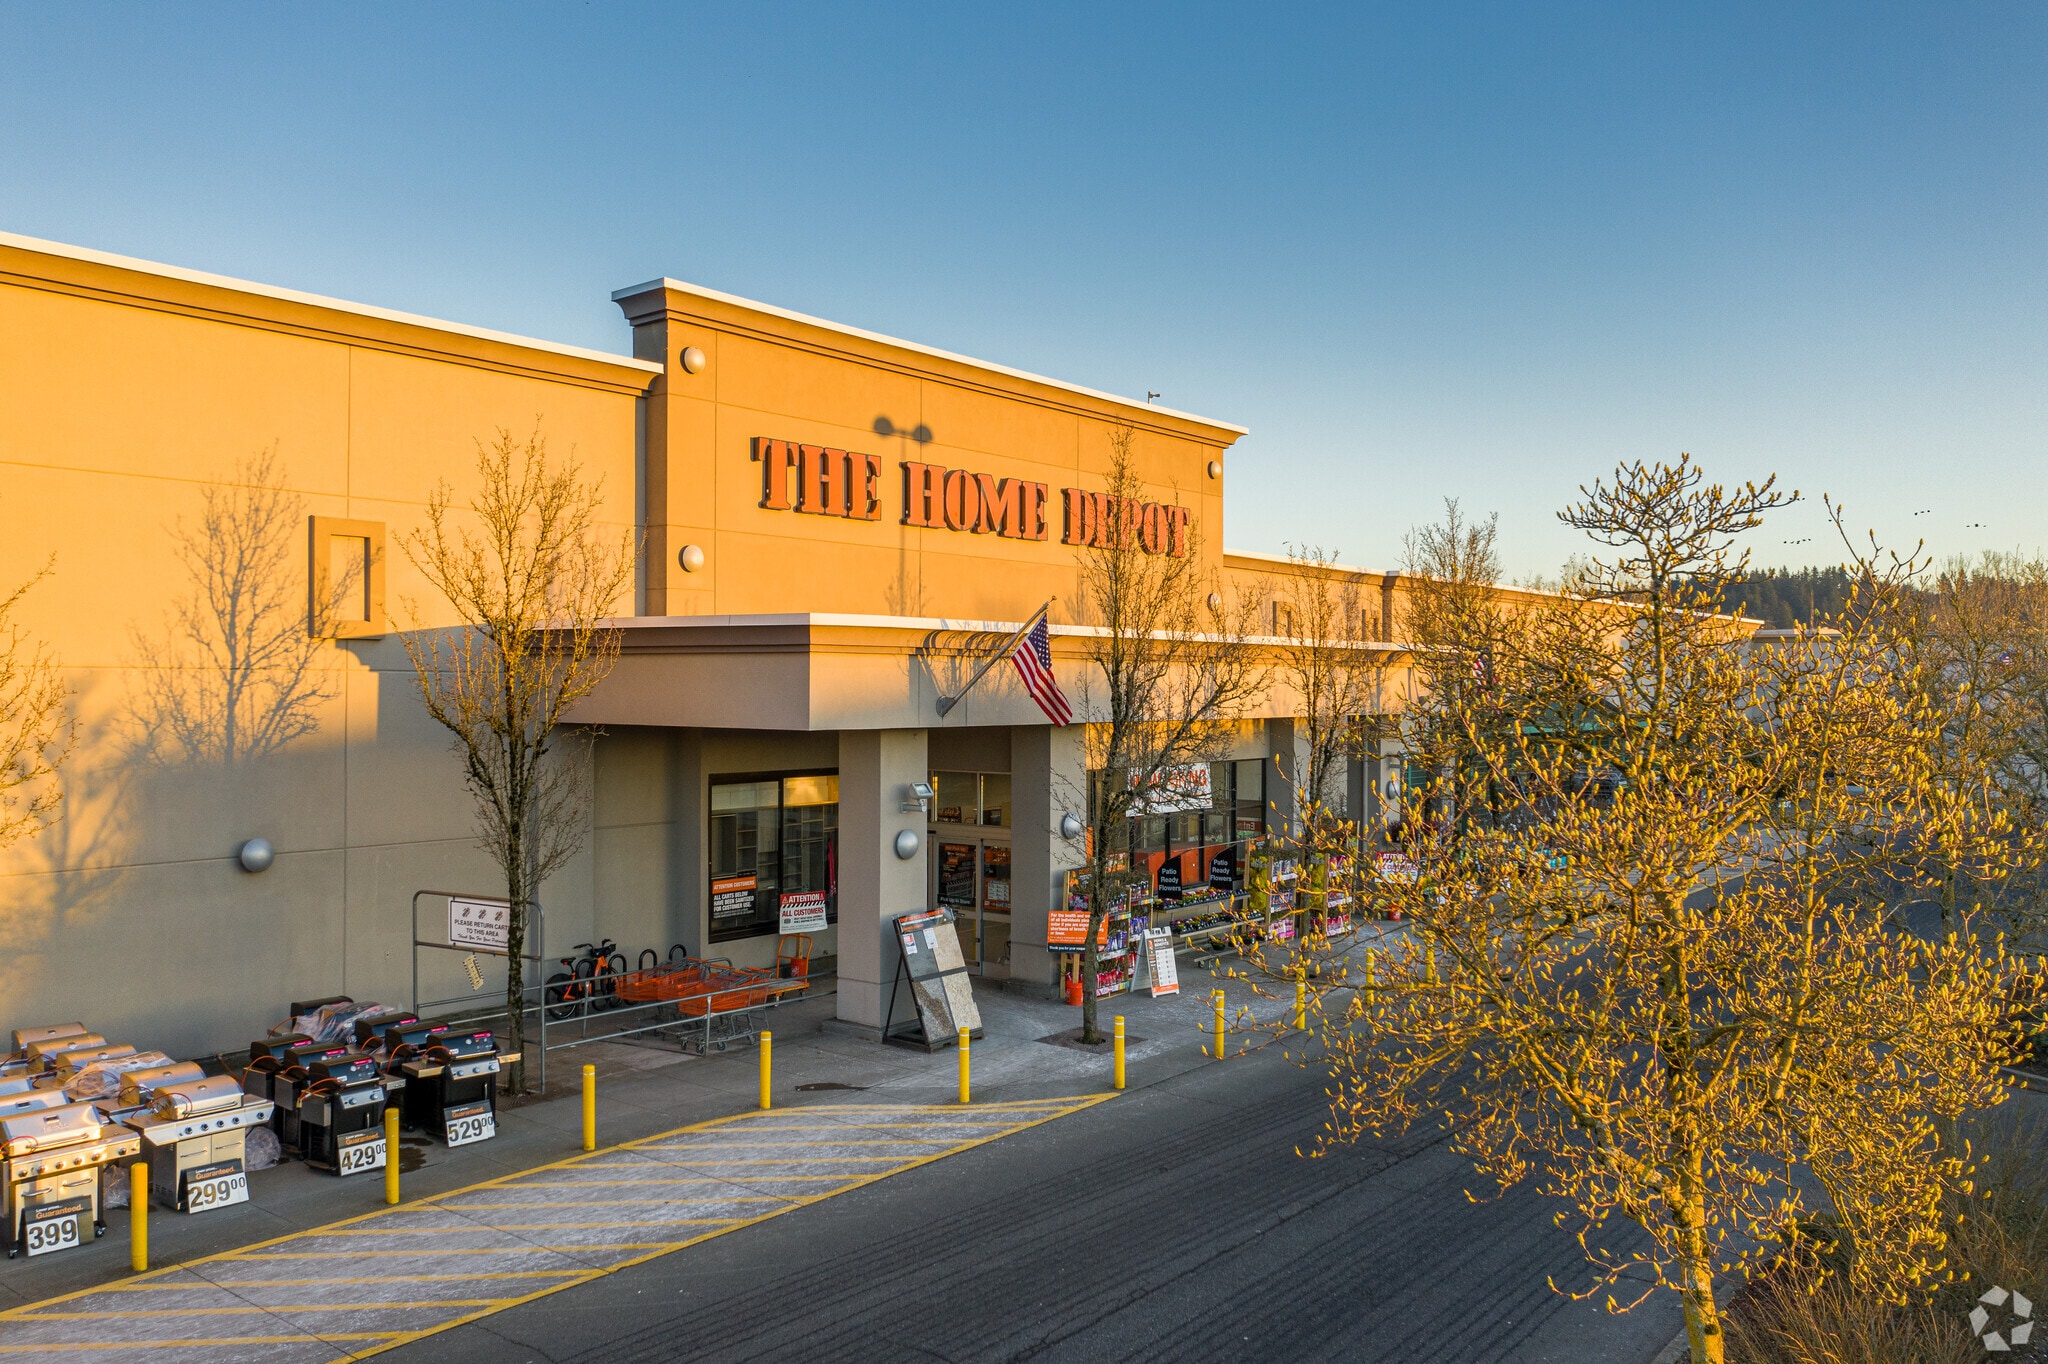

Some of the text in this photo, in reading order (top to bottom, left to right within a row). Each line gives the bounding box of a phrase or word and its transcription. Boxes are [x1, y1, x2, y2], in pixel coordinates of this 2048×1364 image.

[751, 436, 1190, 558] THE HOME DEPOT
[1212, 867, 1230, 875] Ready
[789, 893, 820, 903] ATTENTION
[794, 907, 824, 917] CUSTOMERS
[454, 919, 473, 927] PLEASE
[474, 921, 494, 929] RETURN
[29, 1219, 77, 1250] 399
